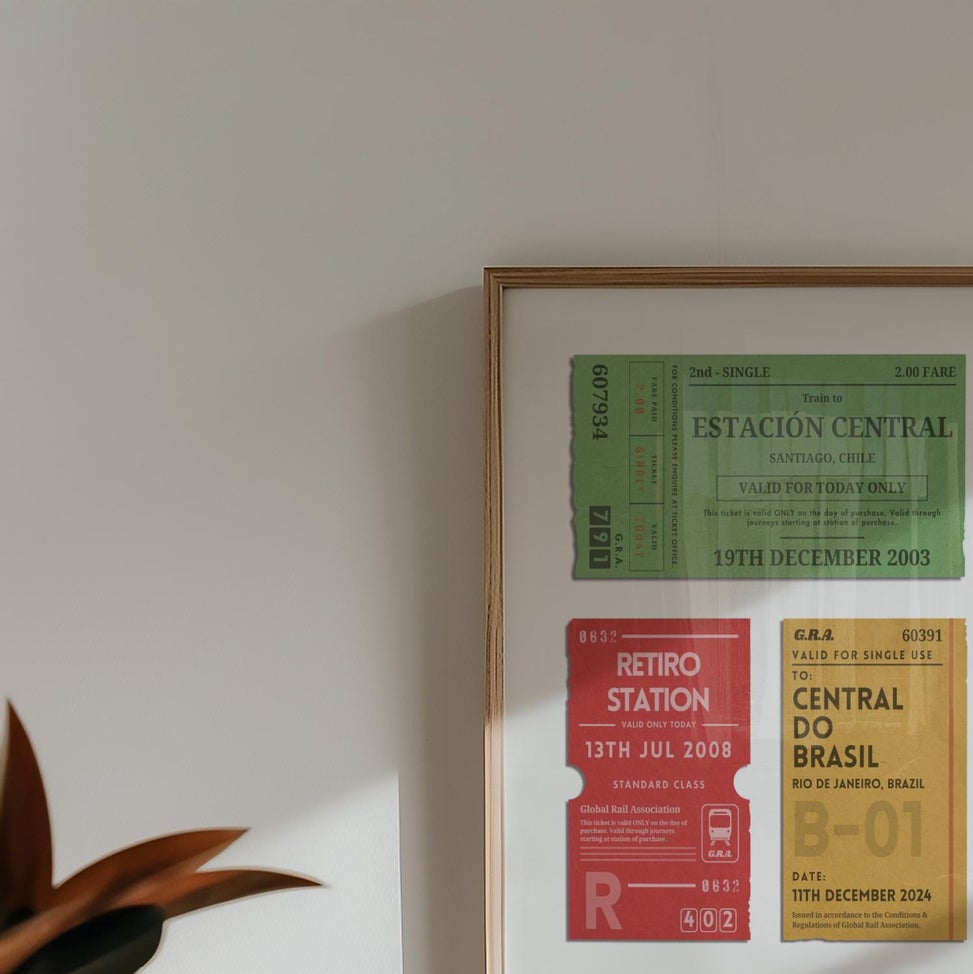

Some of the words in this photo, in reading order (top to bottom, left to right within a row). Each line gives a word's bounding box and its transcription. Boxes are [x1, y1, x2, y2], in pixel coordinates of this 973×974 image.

[671, 365, 679, 379] FOR
[690, 366, 712, 377] 2nd
[722, 367, 770, 378] SINGLE
[895, 367, 919, 377] 2.00
[923, 366, 956, 377] FARE
[650, 377, 658, 398] FARE
[592, 364, 608, 440] 607934
[802, 393, 829, 403] Train
[833, 395, 842, 403] to
[650, 402, 658, 422] PAID
[671, 383, 679, 431] CONDITIONS
[692, 411, 824, 438] ESTACIÓN
[832, 416, 953, 438] CENTRAL
[671, 434, 679, 459] PLEASE
[770, 453, 836, 465] SANTIAGO,
[839, 453, 876, 464] CHILE
[650, 455, 658, 485] TICKET
[671, 464, 679, 496] ENQUIRE
[739, 482, 781, 494] VALID
[786, 482, 812, 494] FOR
[816, 482, 864, 494] TODAY
[868, 482, 906, 494] ONLY
[671, 500, 679, 508] AT
[703, 508, 718, 517] This
[721, 508, 741, 517] ticket
[744, 508, 750, 517] is
[753, 508, 771, 517] valid
[774, 508, 795, 517] ONLY
[810, 508, 820, 517] the
[824, 508, 838, 519] day
[841, 508, 848, 517] of
[851, 509, 886, 519] purchase.
[890, 508, 909, 517] Valid
[911, 508, 941, 519] through
[671, 512, 679, 536] TICKET
[591, 508, 610, 564] 791
[650, 524, 658, 551] VALID
[615, 534, 623, 568] G.R.A.
[714, 549, 763, 566] 19TH
[770, 549, 882, 566] DECEMBER
[887, 549, 930, 566] 2003
[580, 630, 616, 643] 0632
[794, 629, 834, 641] G.R.A.
[903, 629, 942, 642] 60391
[792, 650, 827, 660] VALID
[834, 650, 857, 660] FOR
[864, 650, 905, 660] SINGLE
[912, 650, 932, 660] USE
[617, 652, 701, 676] RETIRO
[792, 671, 812, 680] TO:
[608, 687, 709, 712] STATION
[793, 687, 903, 710] CENTRAL
[794, 716, 833, 739] DO
[586, 741, 630, 758] 13TH
[640, 741, 674, 758] JUL
[684, 741, 731, 758] 2008
[794, 745, 879, 768] BRASIL
[613, 780, 668, 789] STANDARD
[674, 780, 704, 789] CLASS
[793, 778, 812, 789] RIO
[817, 779, 830, 788] DE
[833, 778, 883, 790] JANEIRO,
[888, 778, 925, 789] BRAZIL
[580, 805, 609, 813] Global
[611, 805, 628, 813] Rail
[630, 805, 680, 813] Association
[794, 800, 921, 858] B-01
[708, 850, 732, 858] G.R.A.
[793, 872, 825, 881] DATE:
[586, 872, 623, 930] R
[792, 889, 820, 901] 11TH
[826, 889, 896, 901] DECEMBER
[900, 889, 931, 901] 2024
[683, 909, 735, 929] 402
[792, 911, 814, 919] Issued
[815, 911, 822, 919] in
[824, 911, 862, 919] accordance
[864, 911, 871, 919] to
[872, 911, 883, 919] the
[885, 911, 920, 919] Conditions
[922, 911, 928, 919] &
[792, 921, 832, 930] Regulations
[833, 921, 841, 929] of
[842, 921, 864, 929] Global
[865, 921, 878, 929] Rail
[880, 921, 921, 929] Association.
